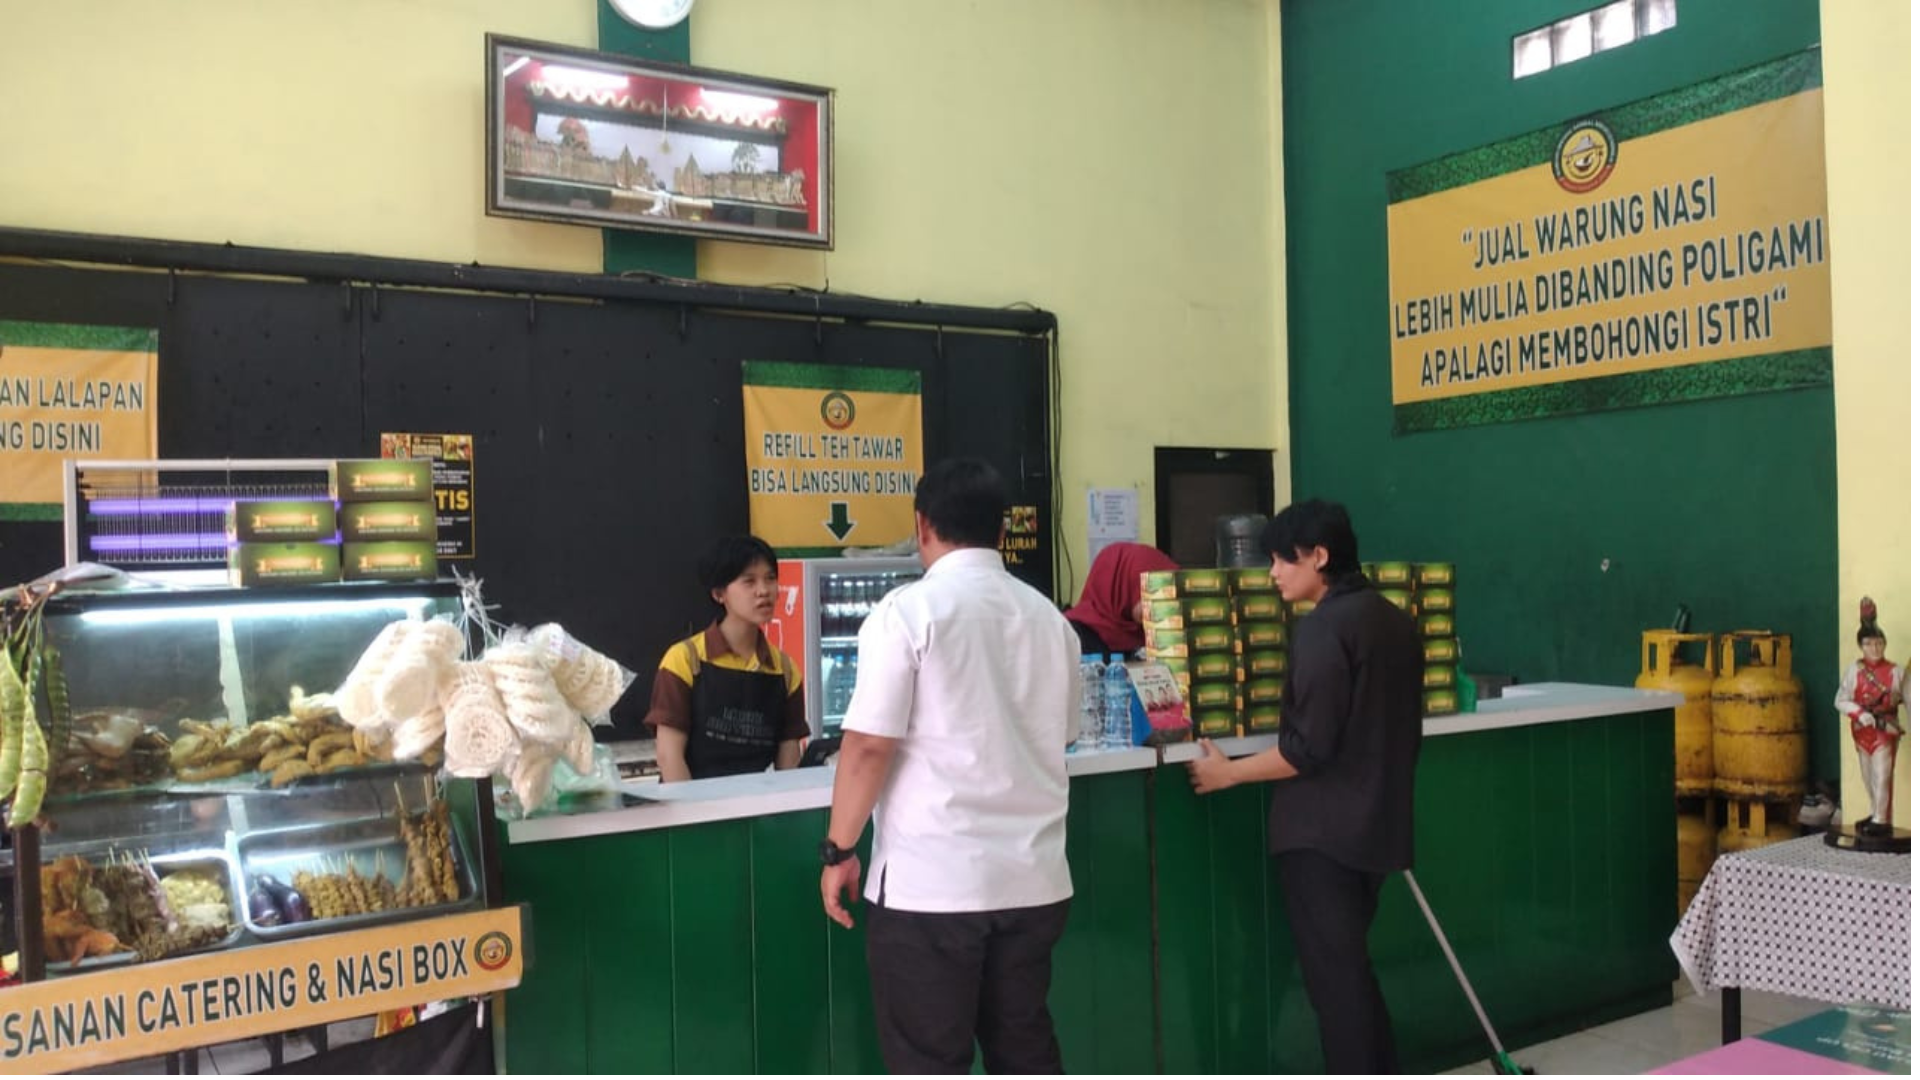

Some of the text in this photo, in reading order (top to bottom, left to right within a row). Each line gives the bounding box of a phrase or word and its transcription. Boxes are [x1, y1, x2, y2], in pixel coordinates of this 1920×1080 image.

[1535, 194, 1644, 254] WARUNG
[1653, 175, 1716, 228] NASI
[1395, 219, 1825, 339] LEBIH MULIA DIBANDING POLIGAMI
[1420, 339, 1511, 388] APALAGI
[1518, 311, 1689, 371] MEMBOHONGI
[0, 377, 143, 410] AN LALAPAN
[32, 422, 101, 452] DISINI
[764, 433, 903, 460] REFILL TEH TAWAR
[752, 470, 787, 493] BISA
[791, 471, 870, 494] LANGSUNG
[2, 994, 127, 1058] SANAN
[138, 969, 296, 1032] CATERING
[307, 962, 327, 1003] &
[336, 951, 405, 998] NASI
[413, 937, 469, 985] BOX
